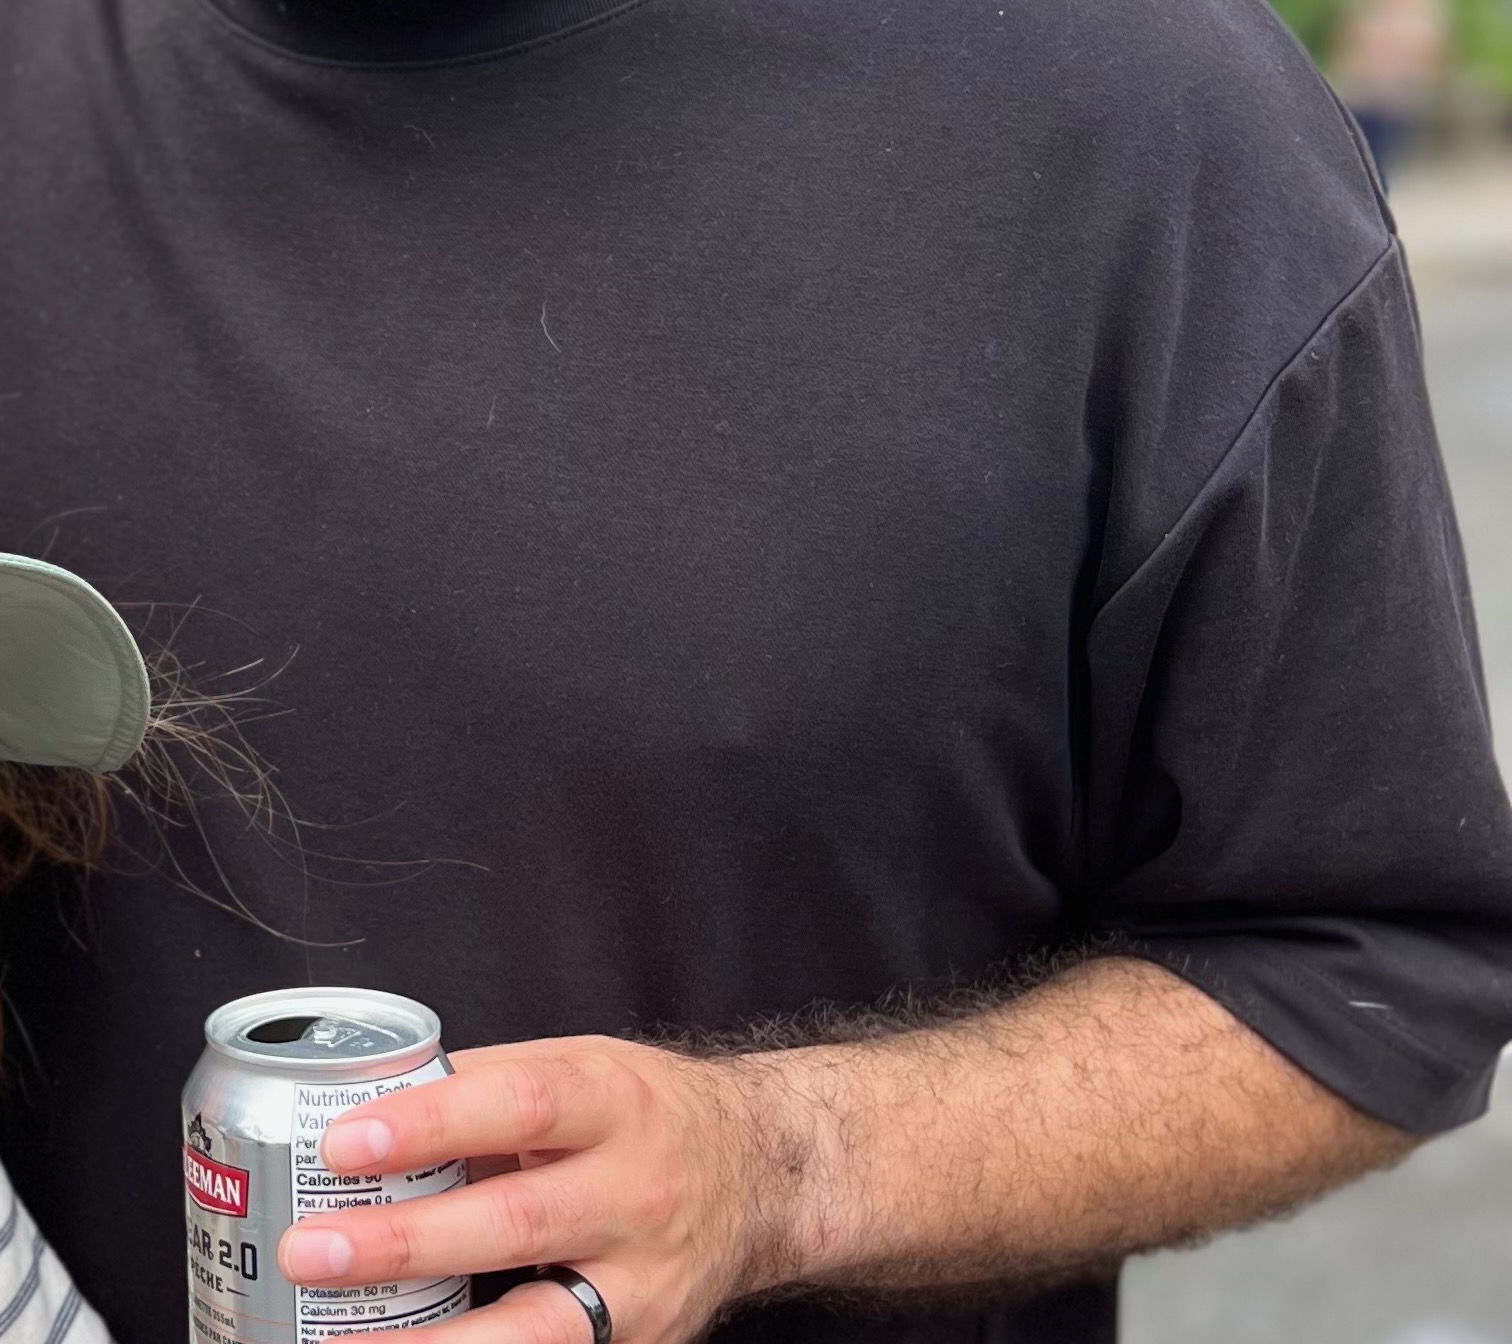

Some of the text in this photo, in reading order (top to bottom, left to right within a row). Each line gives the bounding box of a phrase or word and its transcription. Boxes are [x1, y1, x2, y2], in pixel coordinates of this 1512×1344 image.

[299, 1088, 372, 1107] Nutrition
[295, 1136, 318, 1149] Per
[295, 1154, 318, 1166] par
[296, 1172, 360, 1186] Calories
[297, 1196, 317, 1209] Fat
[318, 1197, 325, 1209] /
[326, 1196, 372, 1210] Lipides
[374, 1194, 383, 1206] 0
[218, 1238, 258, 1281] 2.0
[300, 1283, 399, 1299] Potassium 50 mg
[300, 1304, 387, 1317] Calcium 30 mg
[301, 1326, 317, 1336] Not
